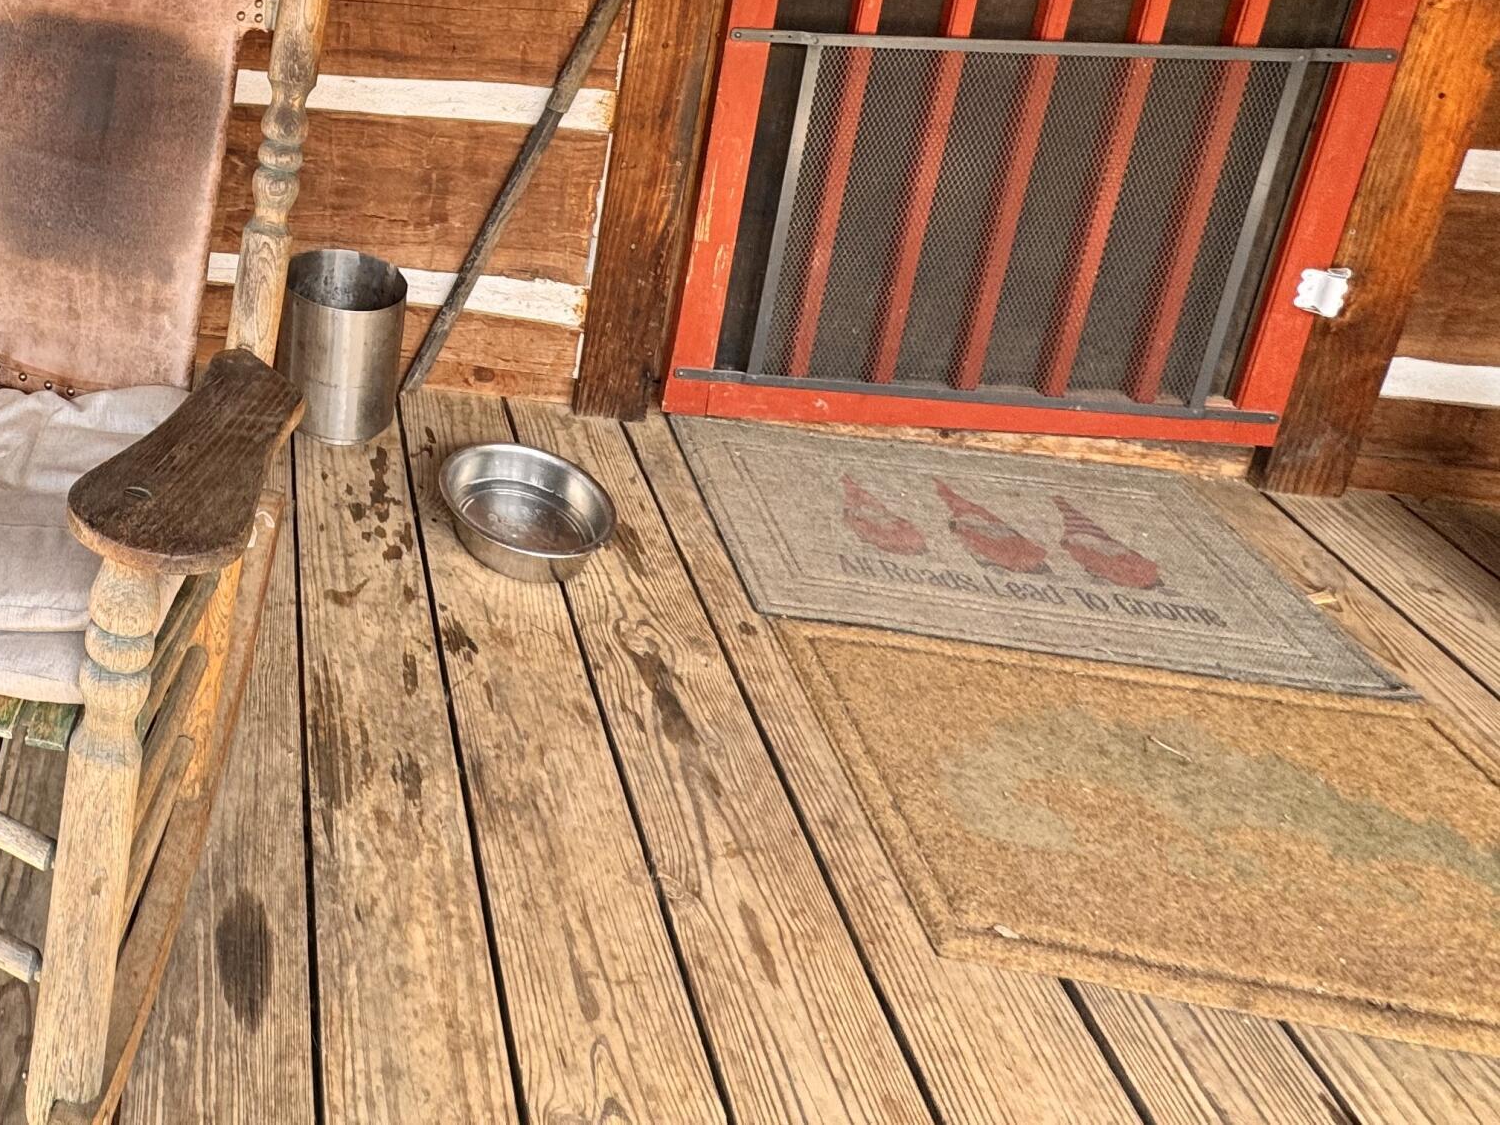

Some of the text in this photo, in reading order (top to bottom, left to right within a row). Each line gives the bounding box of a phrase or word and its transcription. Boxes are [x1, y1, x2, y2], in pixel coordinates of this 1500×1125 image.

[838, 553, 1228, 629] All Roads Lead To Gnome
